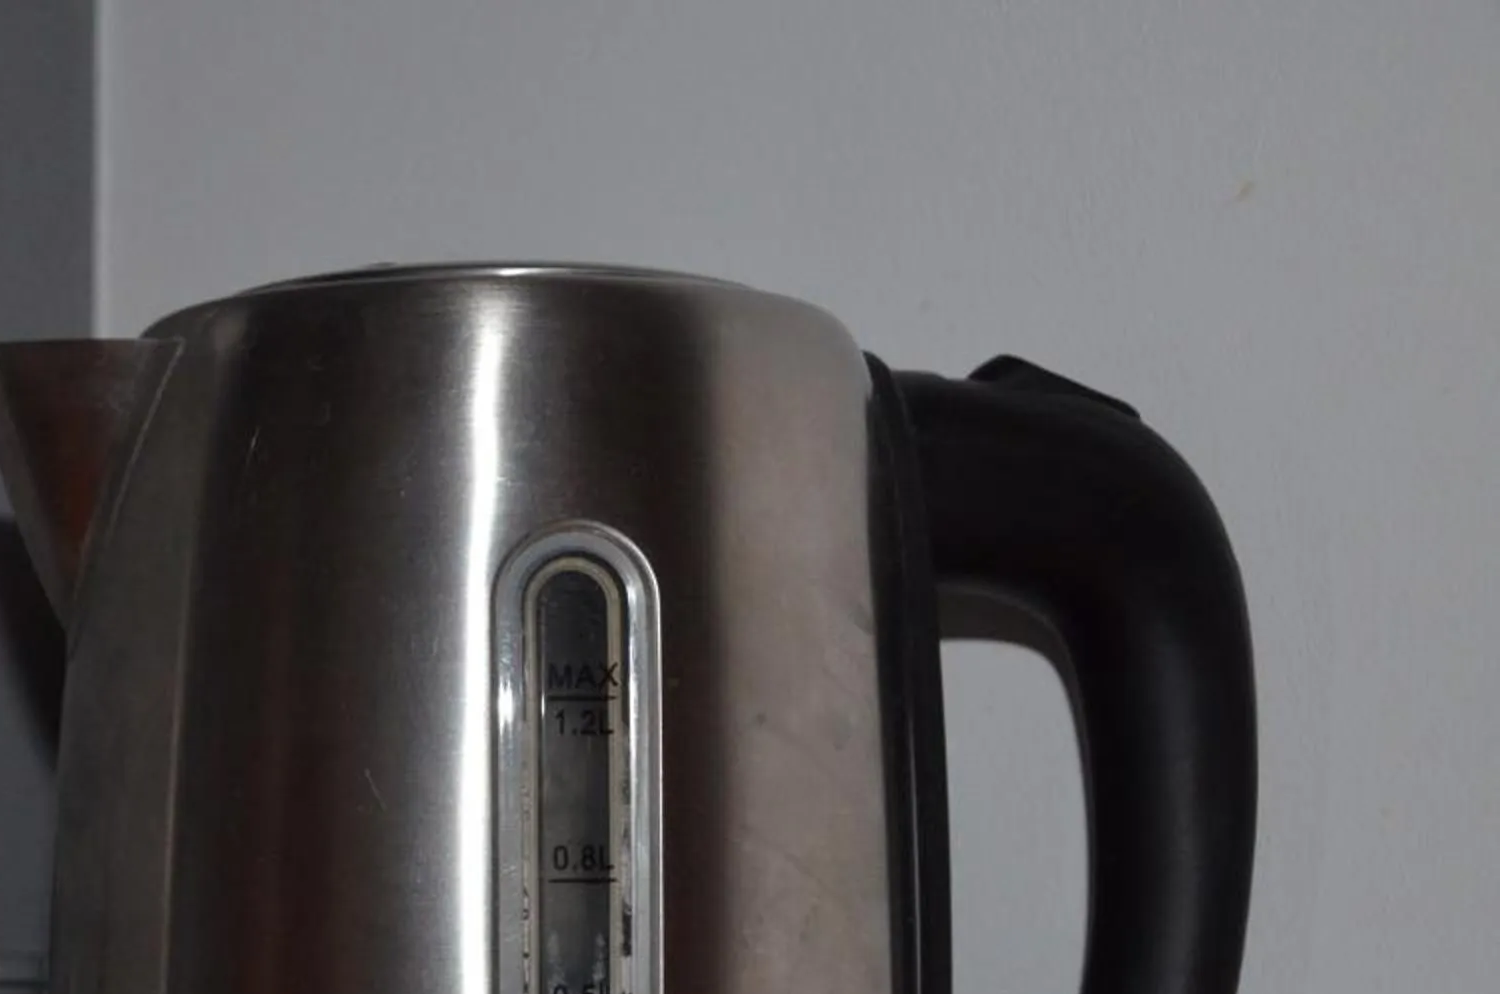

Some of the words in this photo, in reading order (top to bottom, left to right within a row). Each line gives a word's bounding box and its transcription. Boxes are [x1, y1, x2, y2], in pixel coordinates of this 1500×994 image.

[549, 663, 619, 688] MAX
[555, 709, 614, 735] 1.2L
[553, 845, 614, 871] 0.8L
